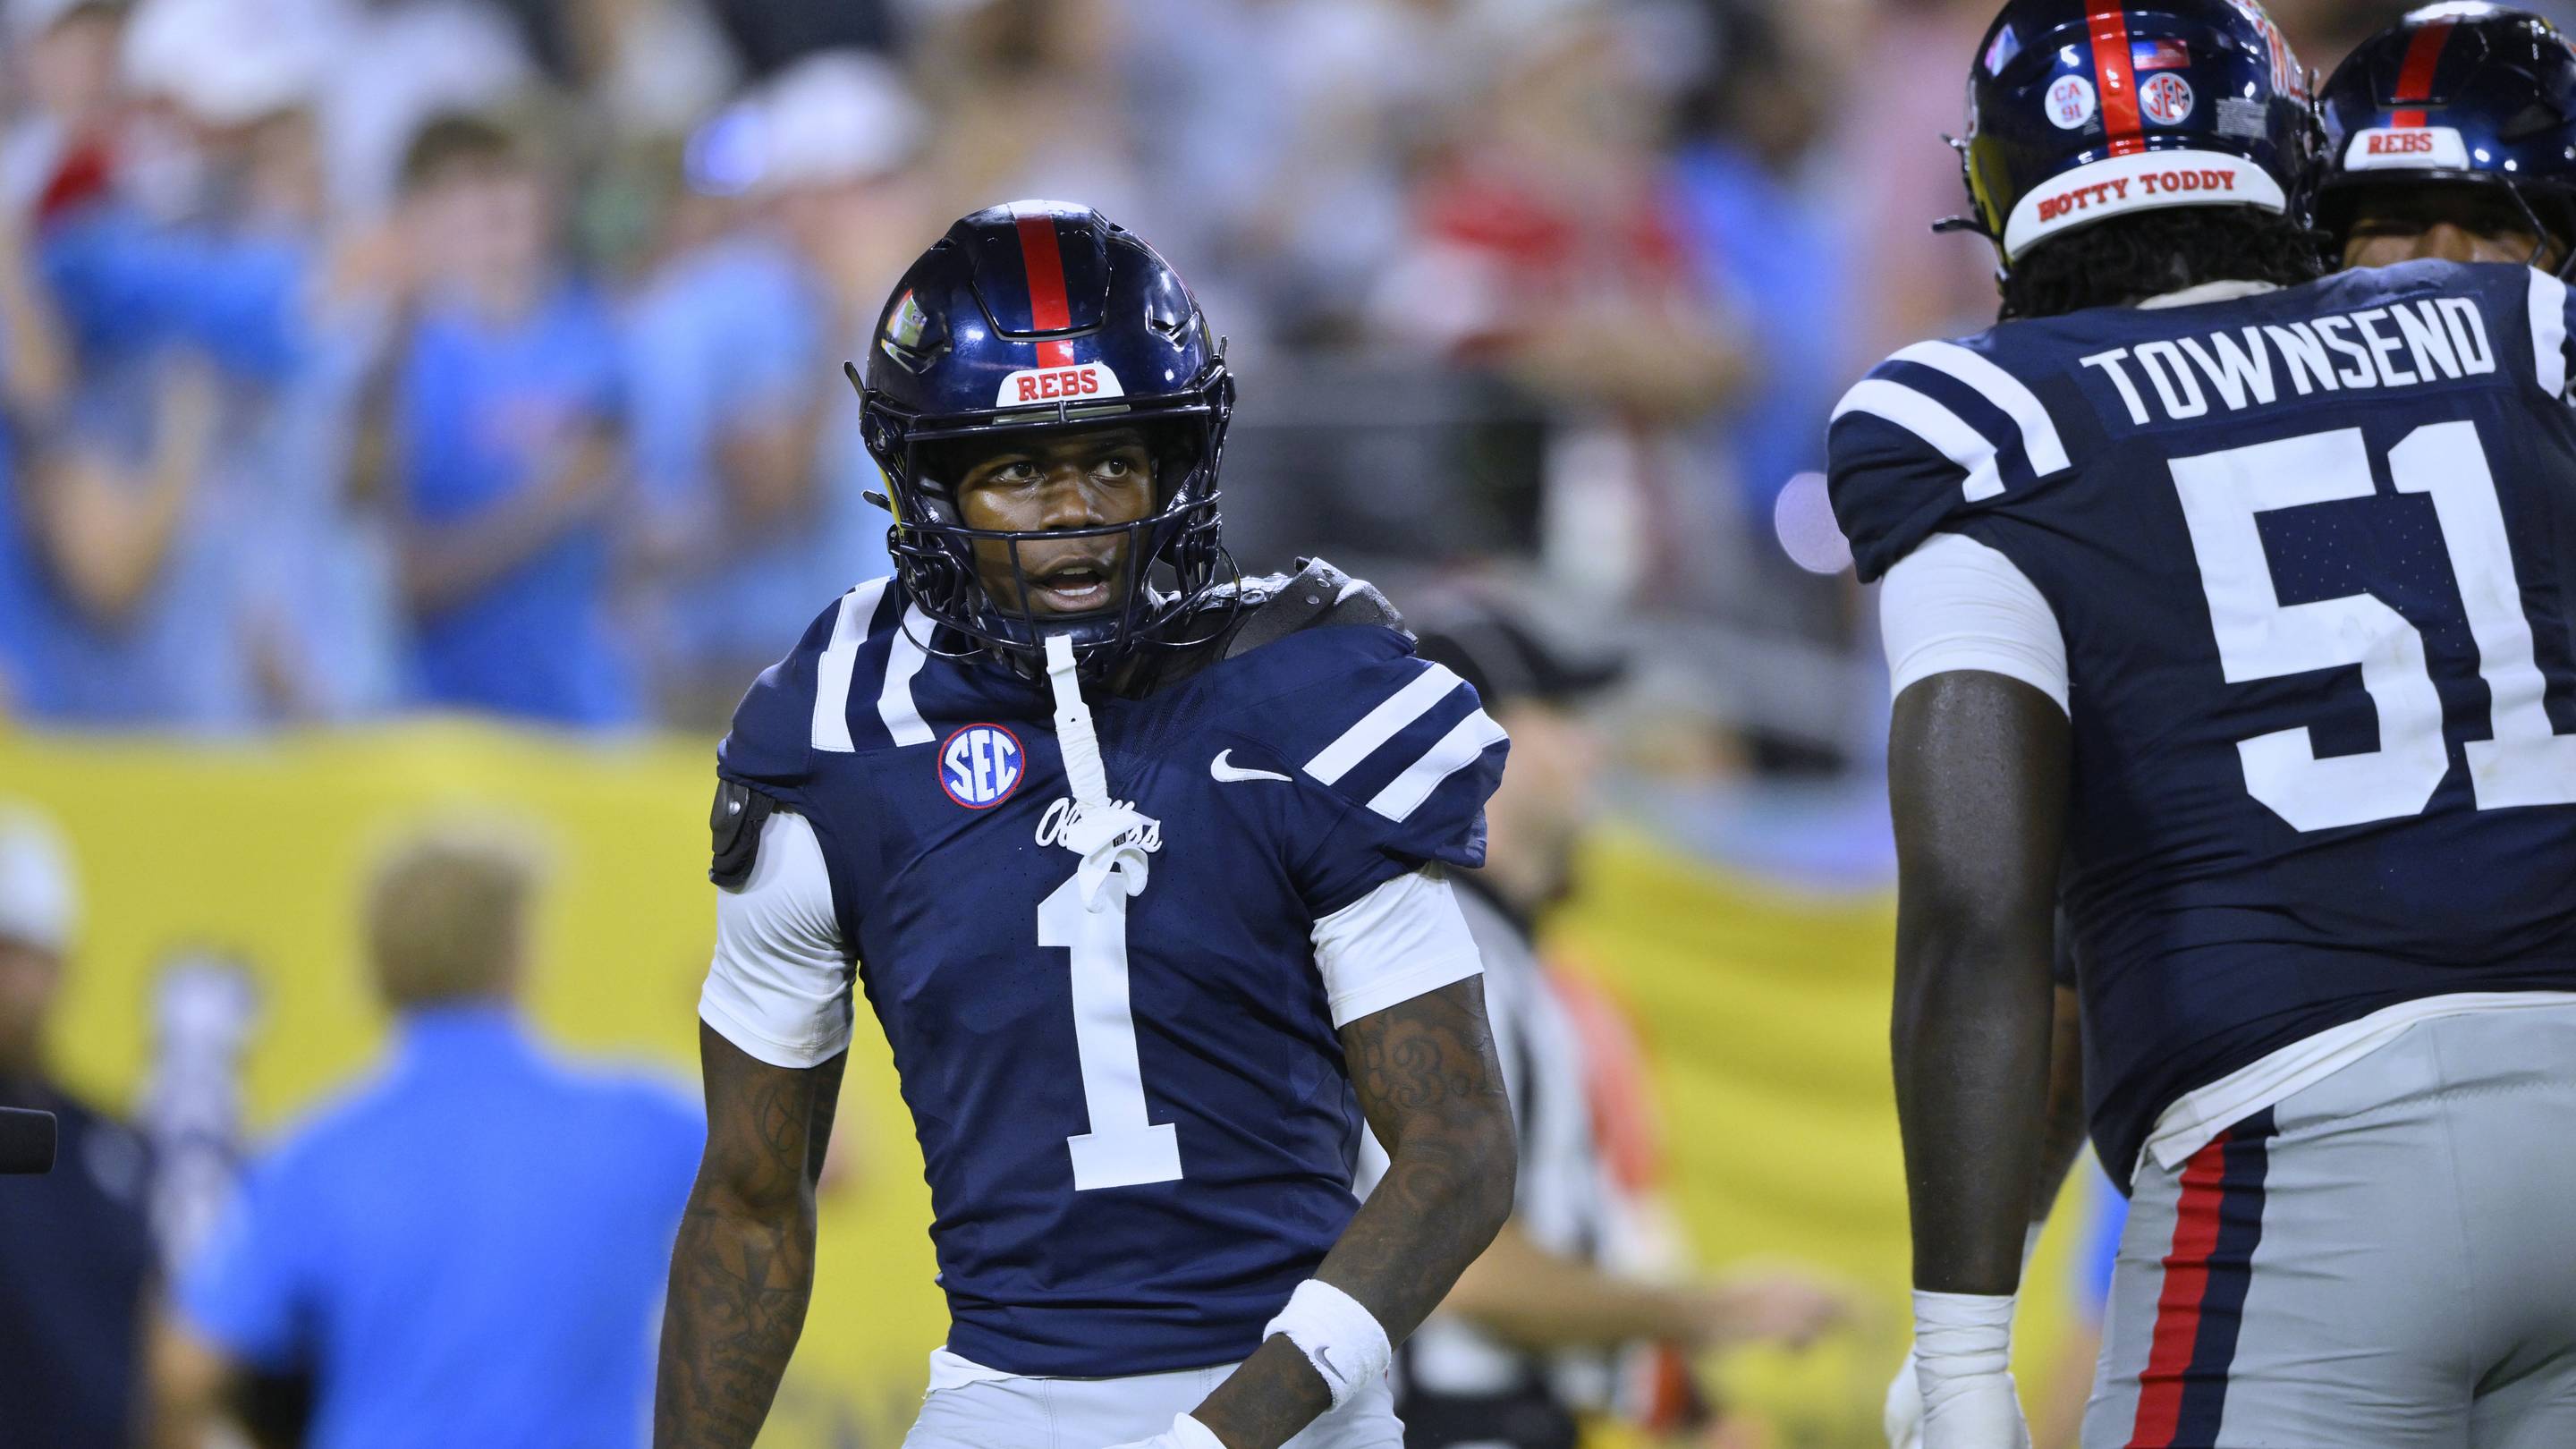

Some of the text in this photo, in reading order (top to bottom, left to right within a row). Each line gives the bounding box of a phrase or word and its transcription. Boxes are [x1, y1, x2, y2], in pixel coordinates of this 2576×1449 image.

[2055, 81, 2083, 103] CA
[2061, 103, 2083, 123] 91
[2144, 75, 2190, 122] SEC
[2368, 132, 2433, 155] REBS
[2038, 170, 2235, 222] HOTTY TODDY
[1016, 369, 1099, 402] REBS
[2080, 297, 2496, 426] TOWNSEND
[2167, 420, 2576, 833] 51
[945, 728, 1018, 803] SEC
[1035, 797, 1084, 848] Ol
[1038, 870, 1183, 1191] 1
